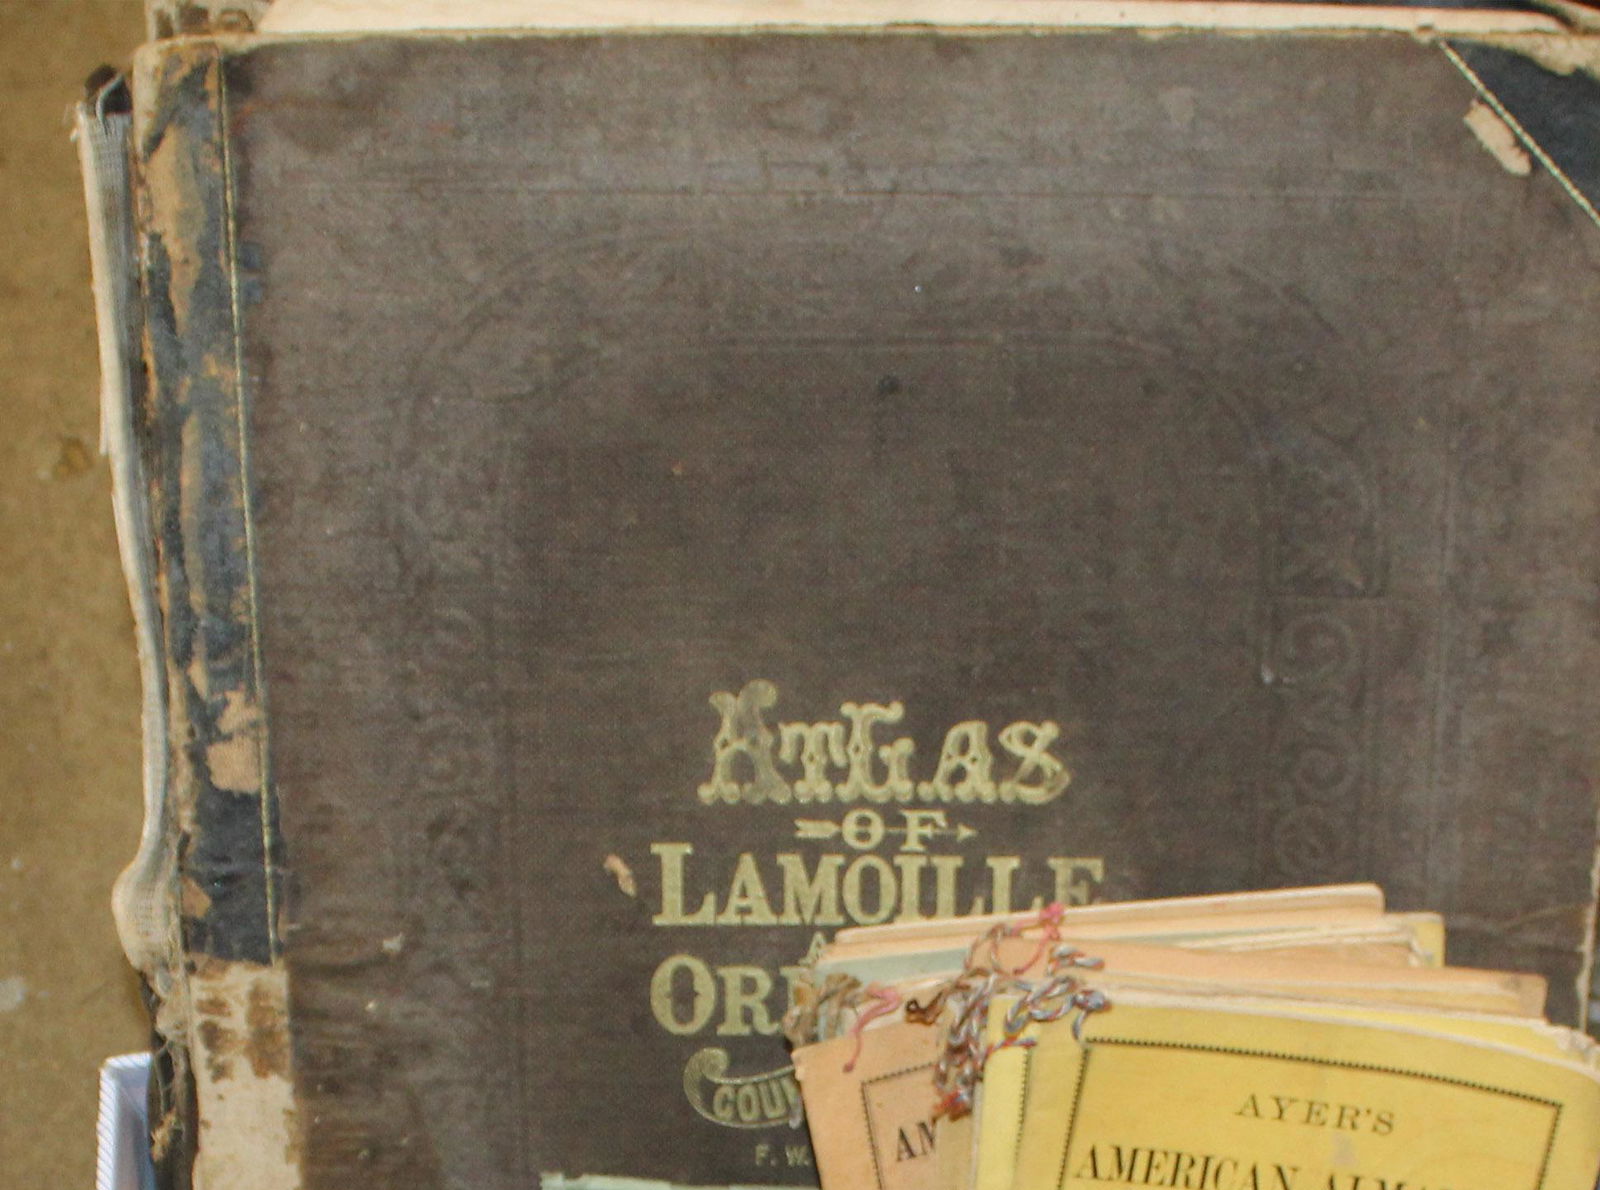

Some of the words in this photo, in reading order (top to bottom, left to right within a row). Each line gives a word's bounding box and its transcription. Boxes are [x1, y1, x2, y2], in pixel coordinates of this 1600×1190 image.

[697, 678, 1072, 805] ATLAS
[841, 808, 948, 852] OF
[650, 842, 1105, 926] LAMOILLE
[1234, 1093, 1395, 1136] AYER'S
